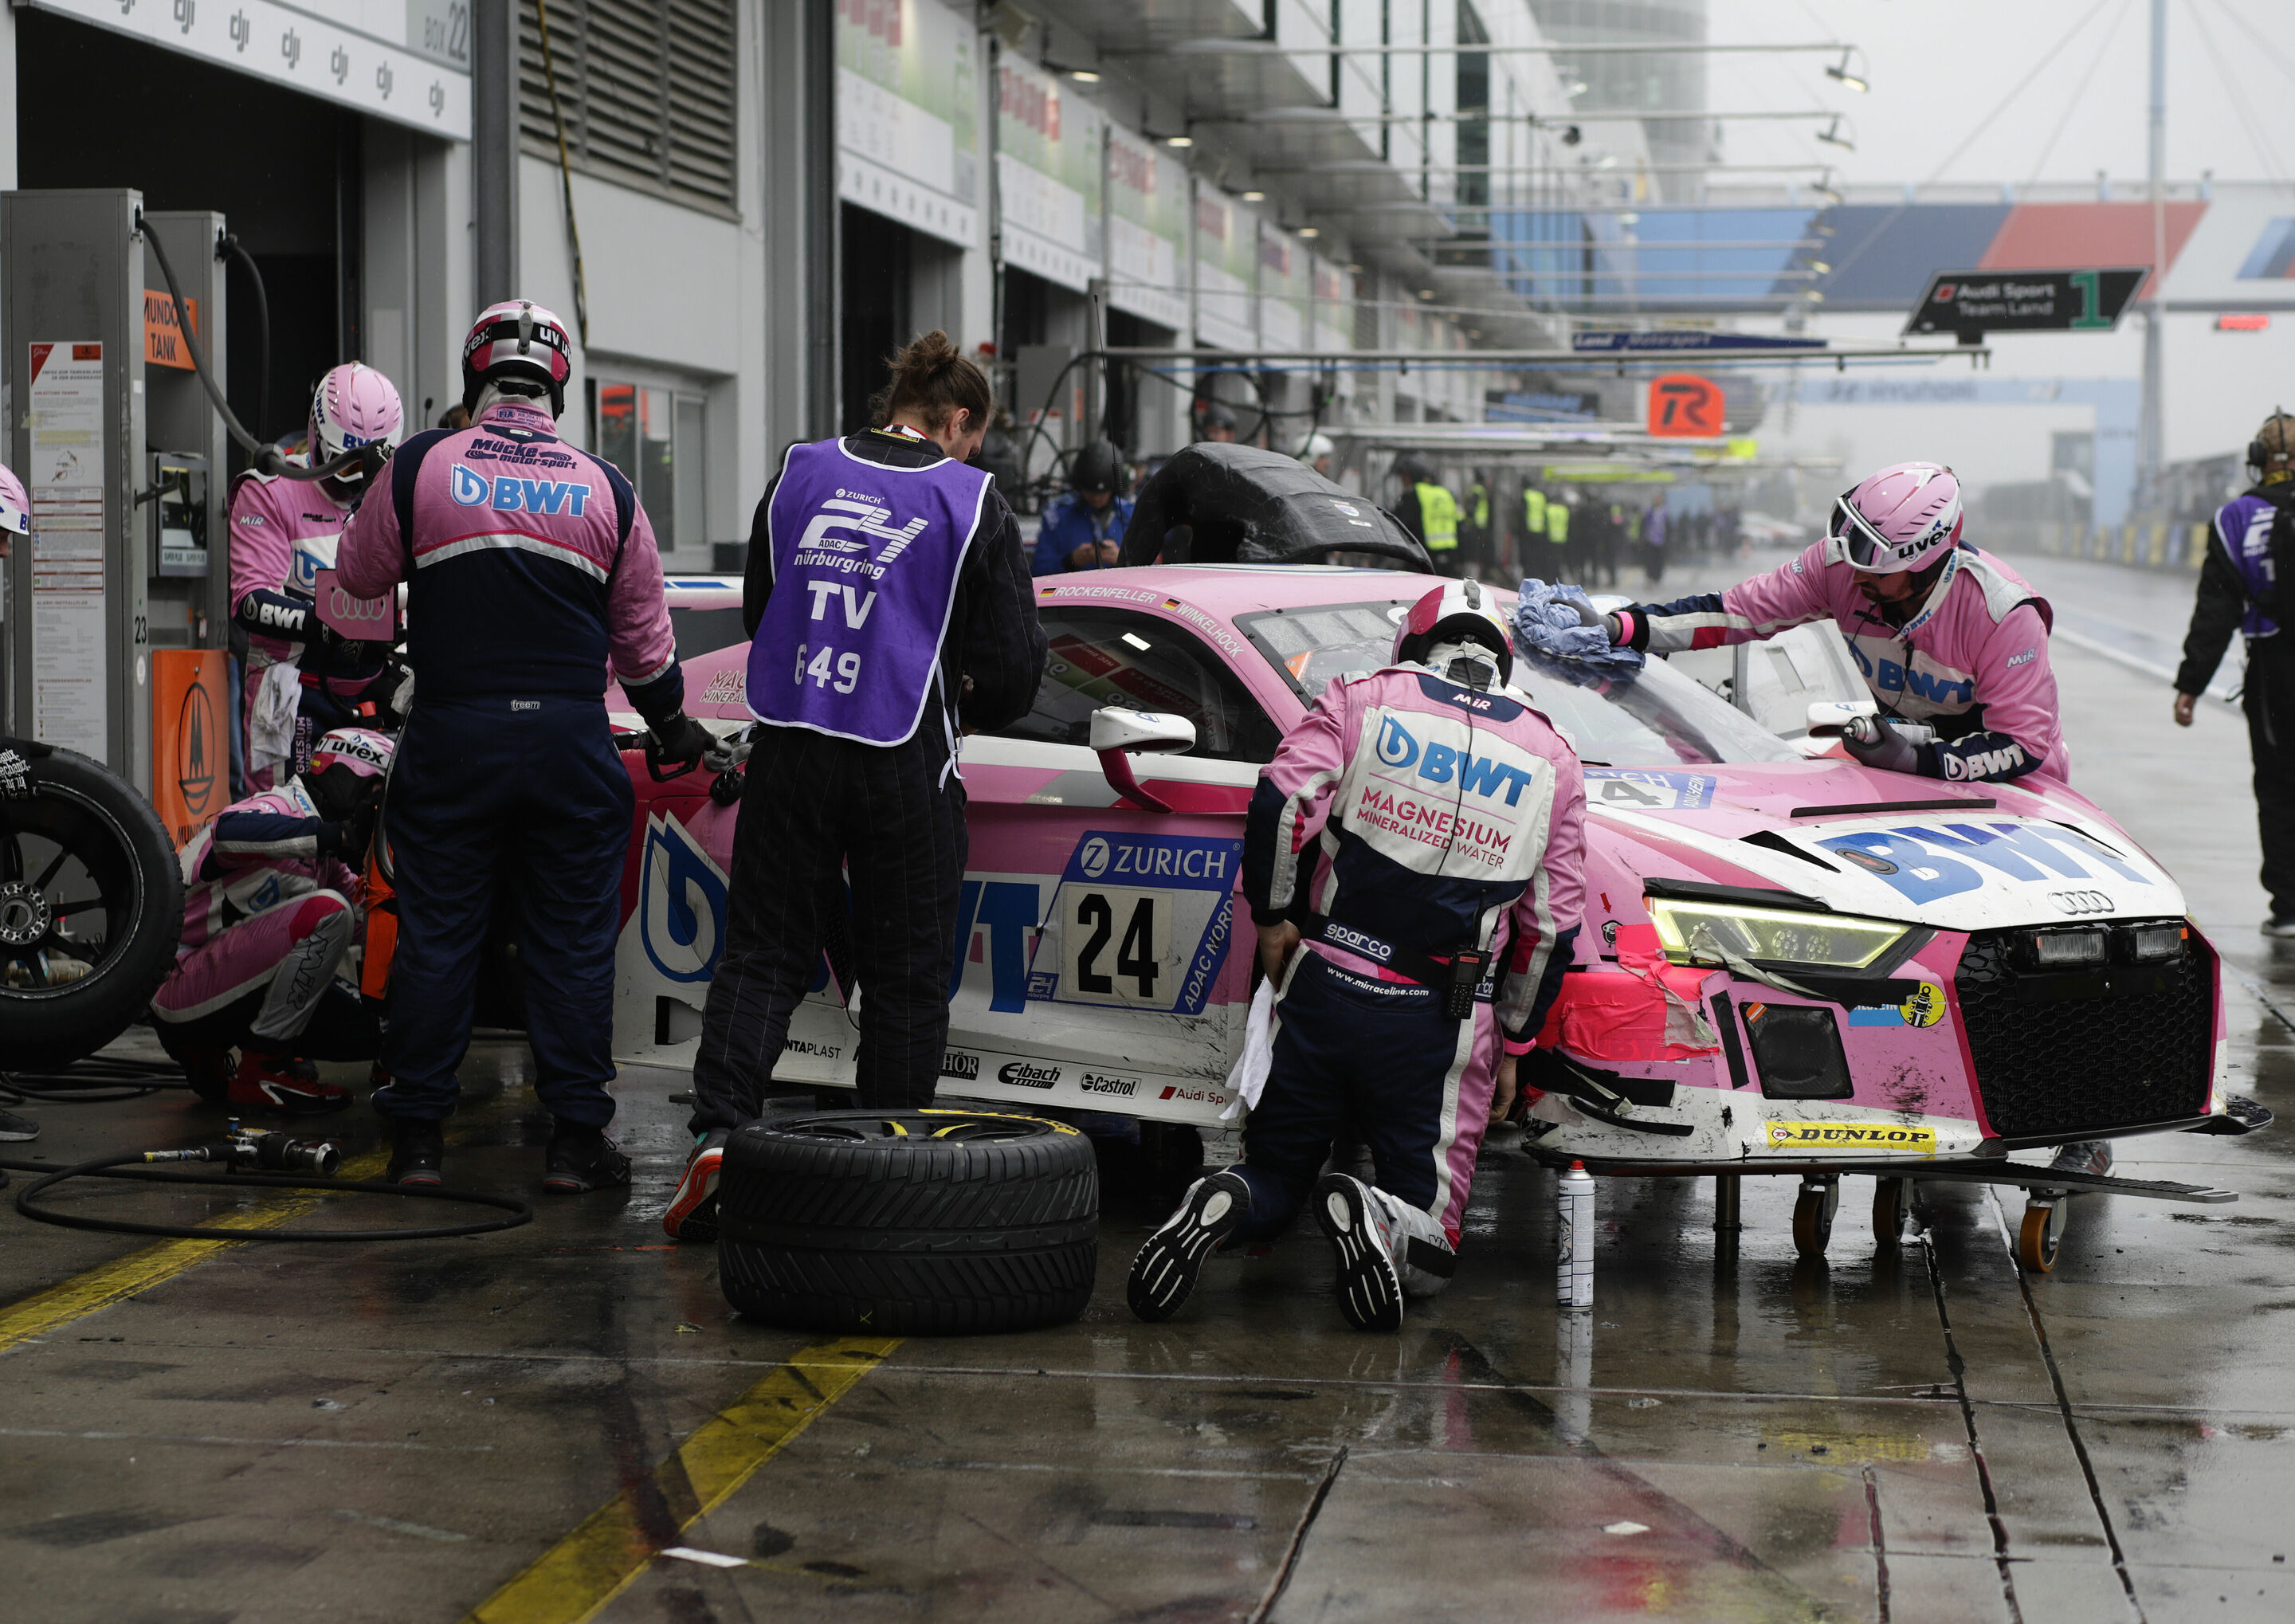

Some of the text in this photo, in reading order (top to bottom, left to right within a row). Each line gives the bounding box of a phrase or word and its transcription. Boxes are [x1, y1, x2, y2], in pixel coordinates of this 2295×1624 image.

[424, 2, 468, 62] BOX 22
[230, 9, 249, 52] dji
[282, 27, 300, 69] dji
[331, 45, 348, 85] dji
[376, 61, 393, 100] dji
[429, 80, 445, 117] dji
[1957, 284, 2000, 299] Audi
[151, 332, 177, 362] TANK
[470, 439, 539, 457] Mücke
[497, 453, 577, 470] motorsport
[491, 474, 592, 518] BWT
[845, 491, 881, 504] ZURICH
[818, 539, 842, 549] ADAC
[1898, 524, 1953, 559] uvex
[794, 550, 886, 580] nürburgring
[807, 579, 877, 630] TV
[1055, 586, 1157, 604] ROCKENFELLER
[135, 617, 147, 644] 23
[1175, 603, 1244, 658] WINKELHOCK
[794, 643, 861, 695] 649
[2006, 648, 2036, 669] MiR
[1877, 658, 1976, 705] BWT
[1453, 692, 1492, 712] MiR
[296, 716, 306, 774] GNESIUM
[332, 739, 385, 765] uvex
[1418, 741, 1532, 808] BWT
[1966, 743, 2026, 782] BWT
[1360, 785, 1512, 854] MAGNESIUM
[1356, 807, 1504, 870] MINERALIZED WATER
[1112, 845, 1228, 879] ZURICH
[1813, 822, 2156, 906] BWT
[1077, 893, 1159, 998] 24
[1326, 923, 1391, 958] sparco
[1184, 955, 1212, 1012] ADAC
[1327, 966, 1430, 996] www.mirraceline.com
[785, 1038, 842, 1060] NTAPLAST
[941, 1051, 979, 1075] HÖR
[998, 1062, 1061, 1085] Eibach
[1093, 1077, 1137, 1096] Castrol
[1175, 1089, 1205, 1101] Audi
[1797, 1128, 1930, 1143] DUNLOP
